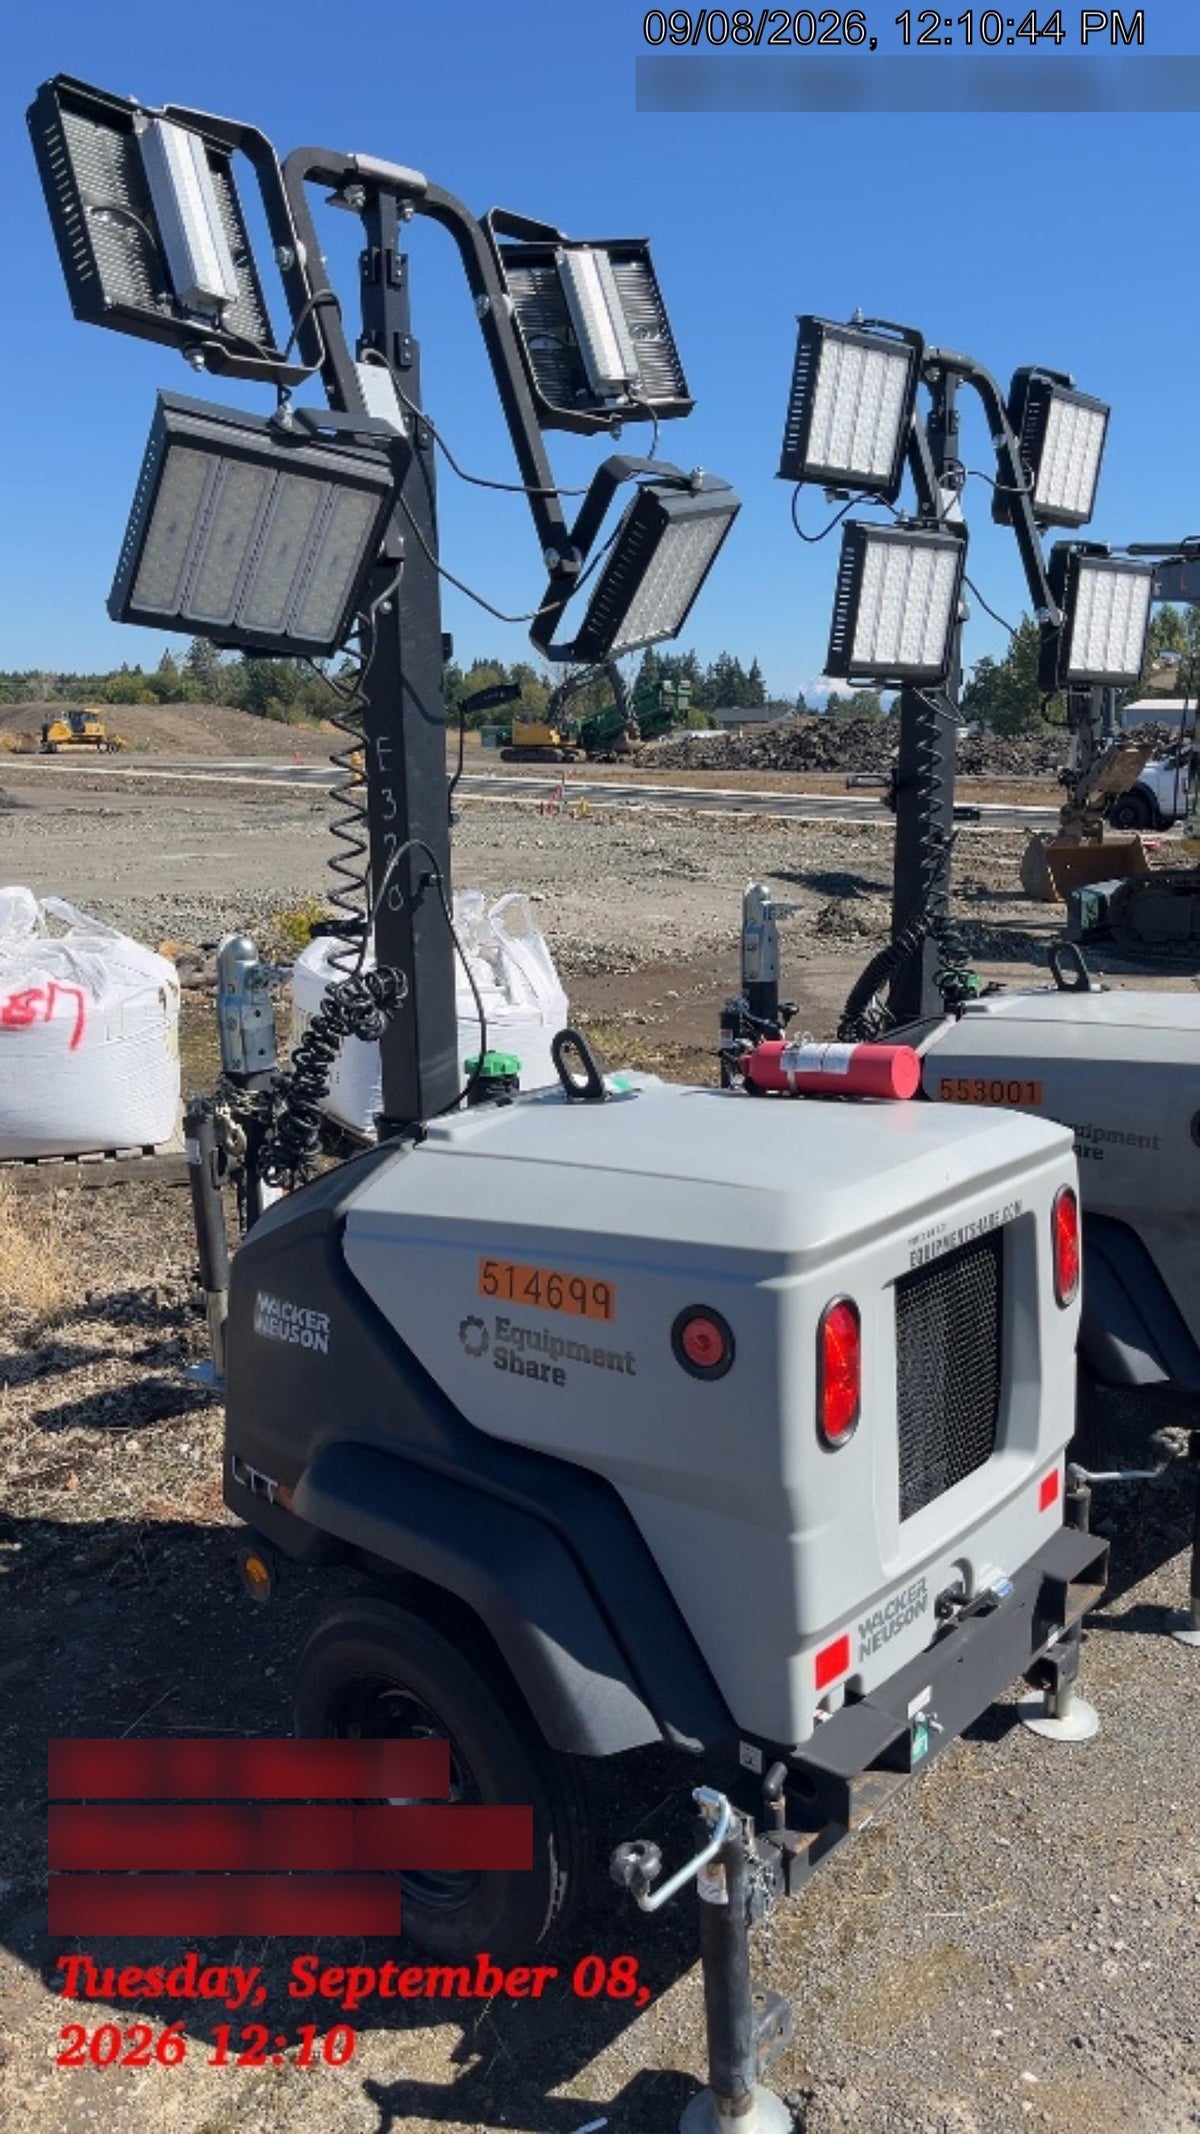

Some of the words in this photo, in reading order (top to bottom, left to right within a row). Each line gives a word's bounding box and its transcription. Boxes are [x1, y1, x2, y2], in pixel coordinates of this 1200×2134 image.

[940, 1078, 1037, 1104] 553001
[256, 1291, 331, 1334] WACKER
[482, 1260, 612, 1319] 514699
[254, 1312, 329, 1355] NEUSON
[495, 1315, 637, 1376] Equipment
[493, 1346, 567, 1387] Share
[858, 1576, 928, 1639] WACKER
[859, 1593, 928, 1663] NEUSON
